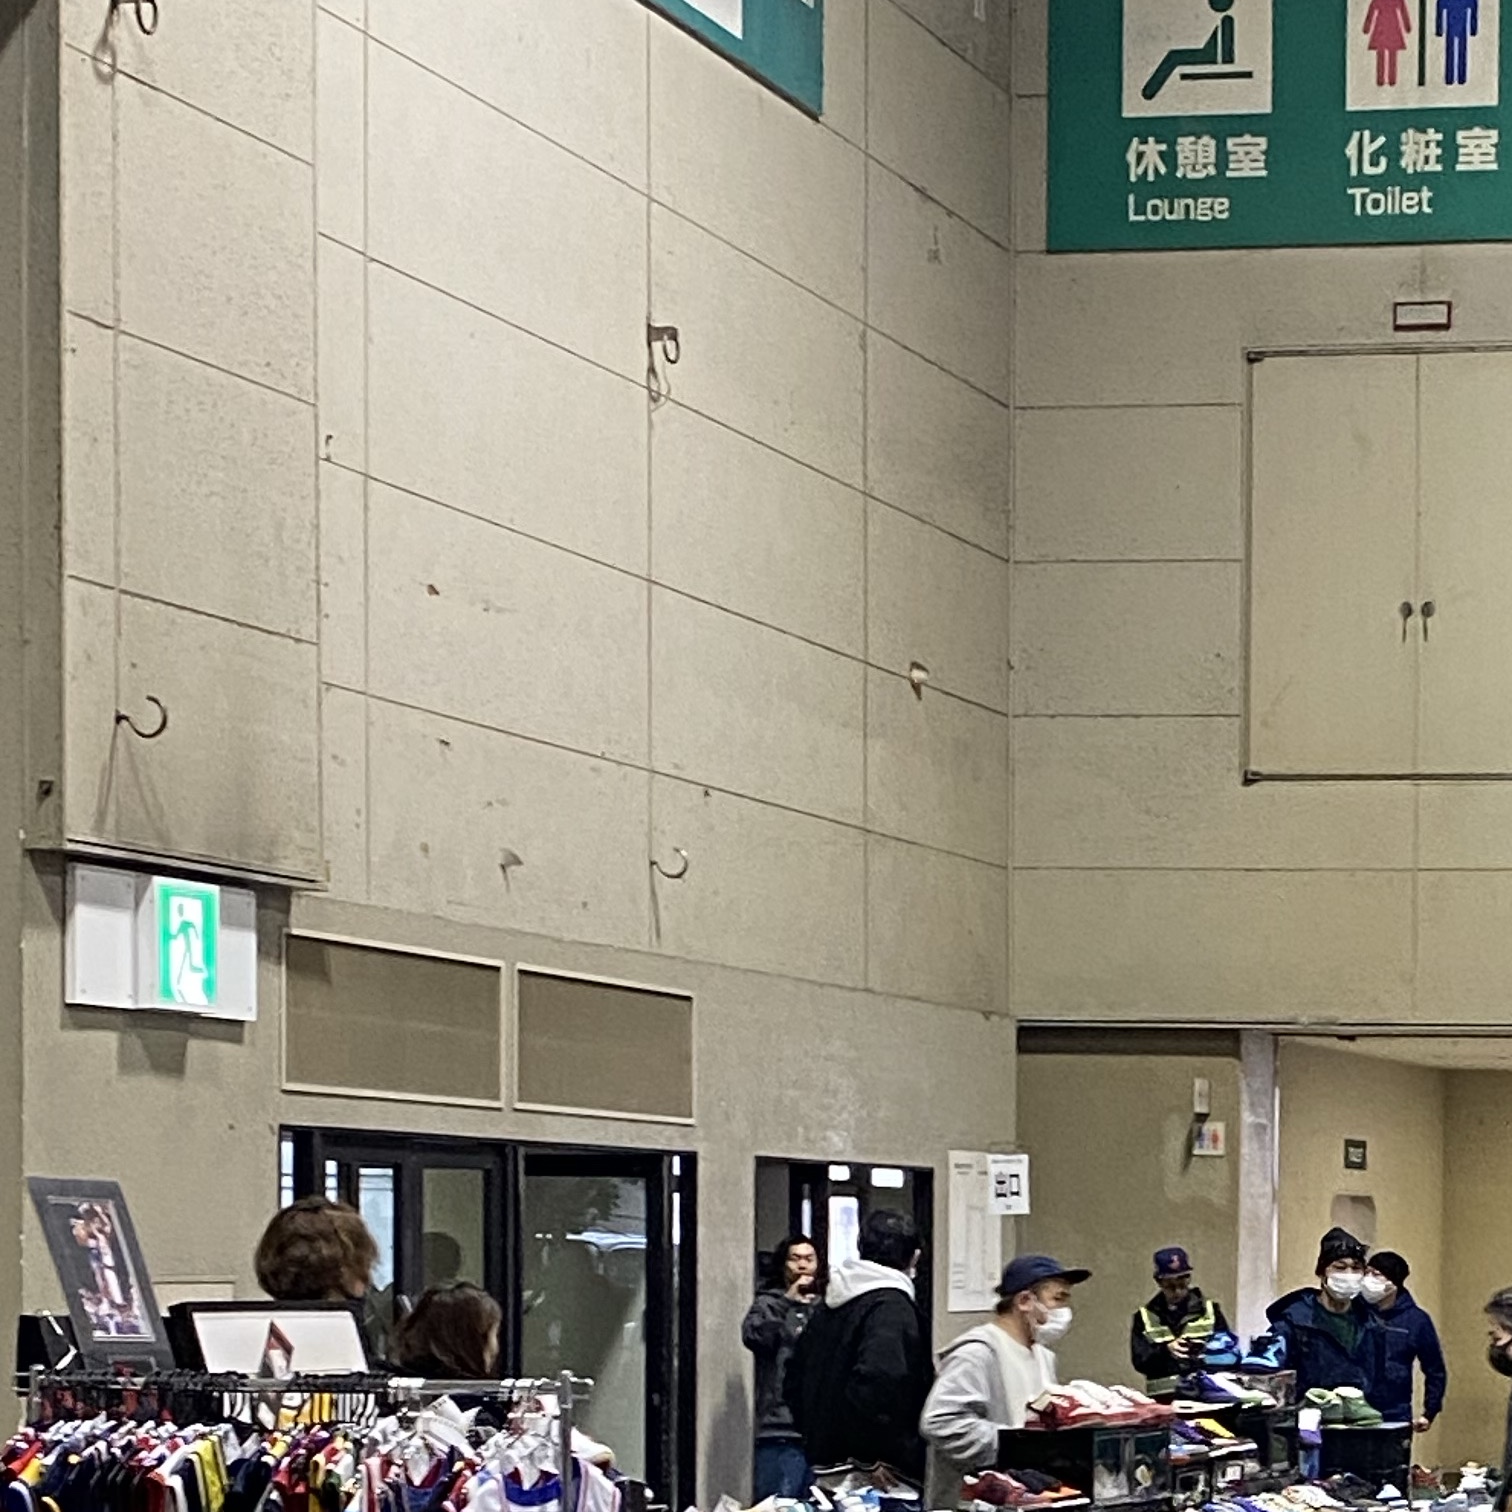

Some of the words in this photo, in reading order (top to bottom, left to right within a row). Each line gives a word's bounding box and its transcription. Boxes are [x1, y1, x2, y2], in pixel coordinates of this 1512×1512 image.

[1125, 133, 1269, 183] 休憩室
[1344, 126, 1500, 178] 化粧室
[1127, 193, 1231, 222] Lounge
[1346, 185, 1434, 217] Toilet
